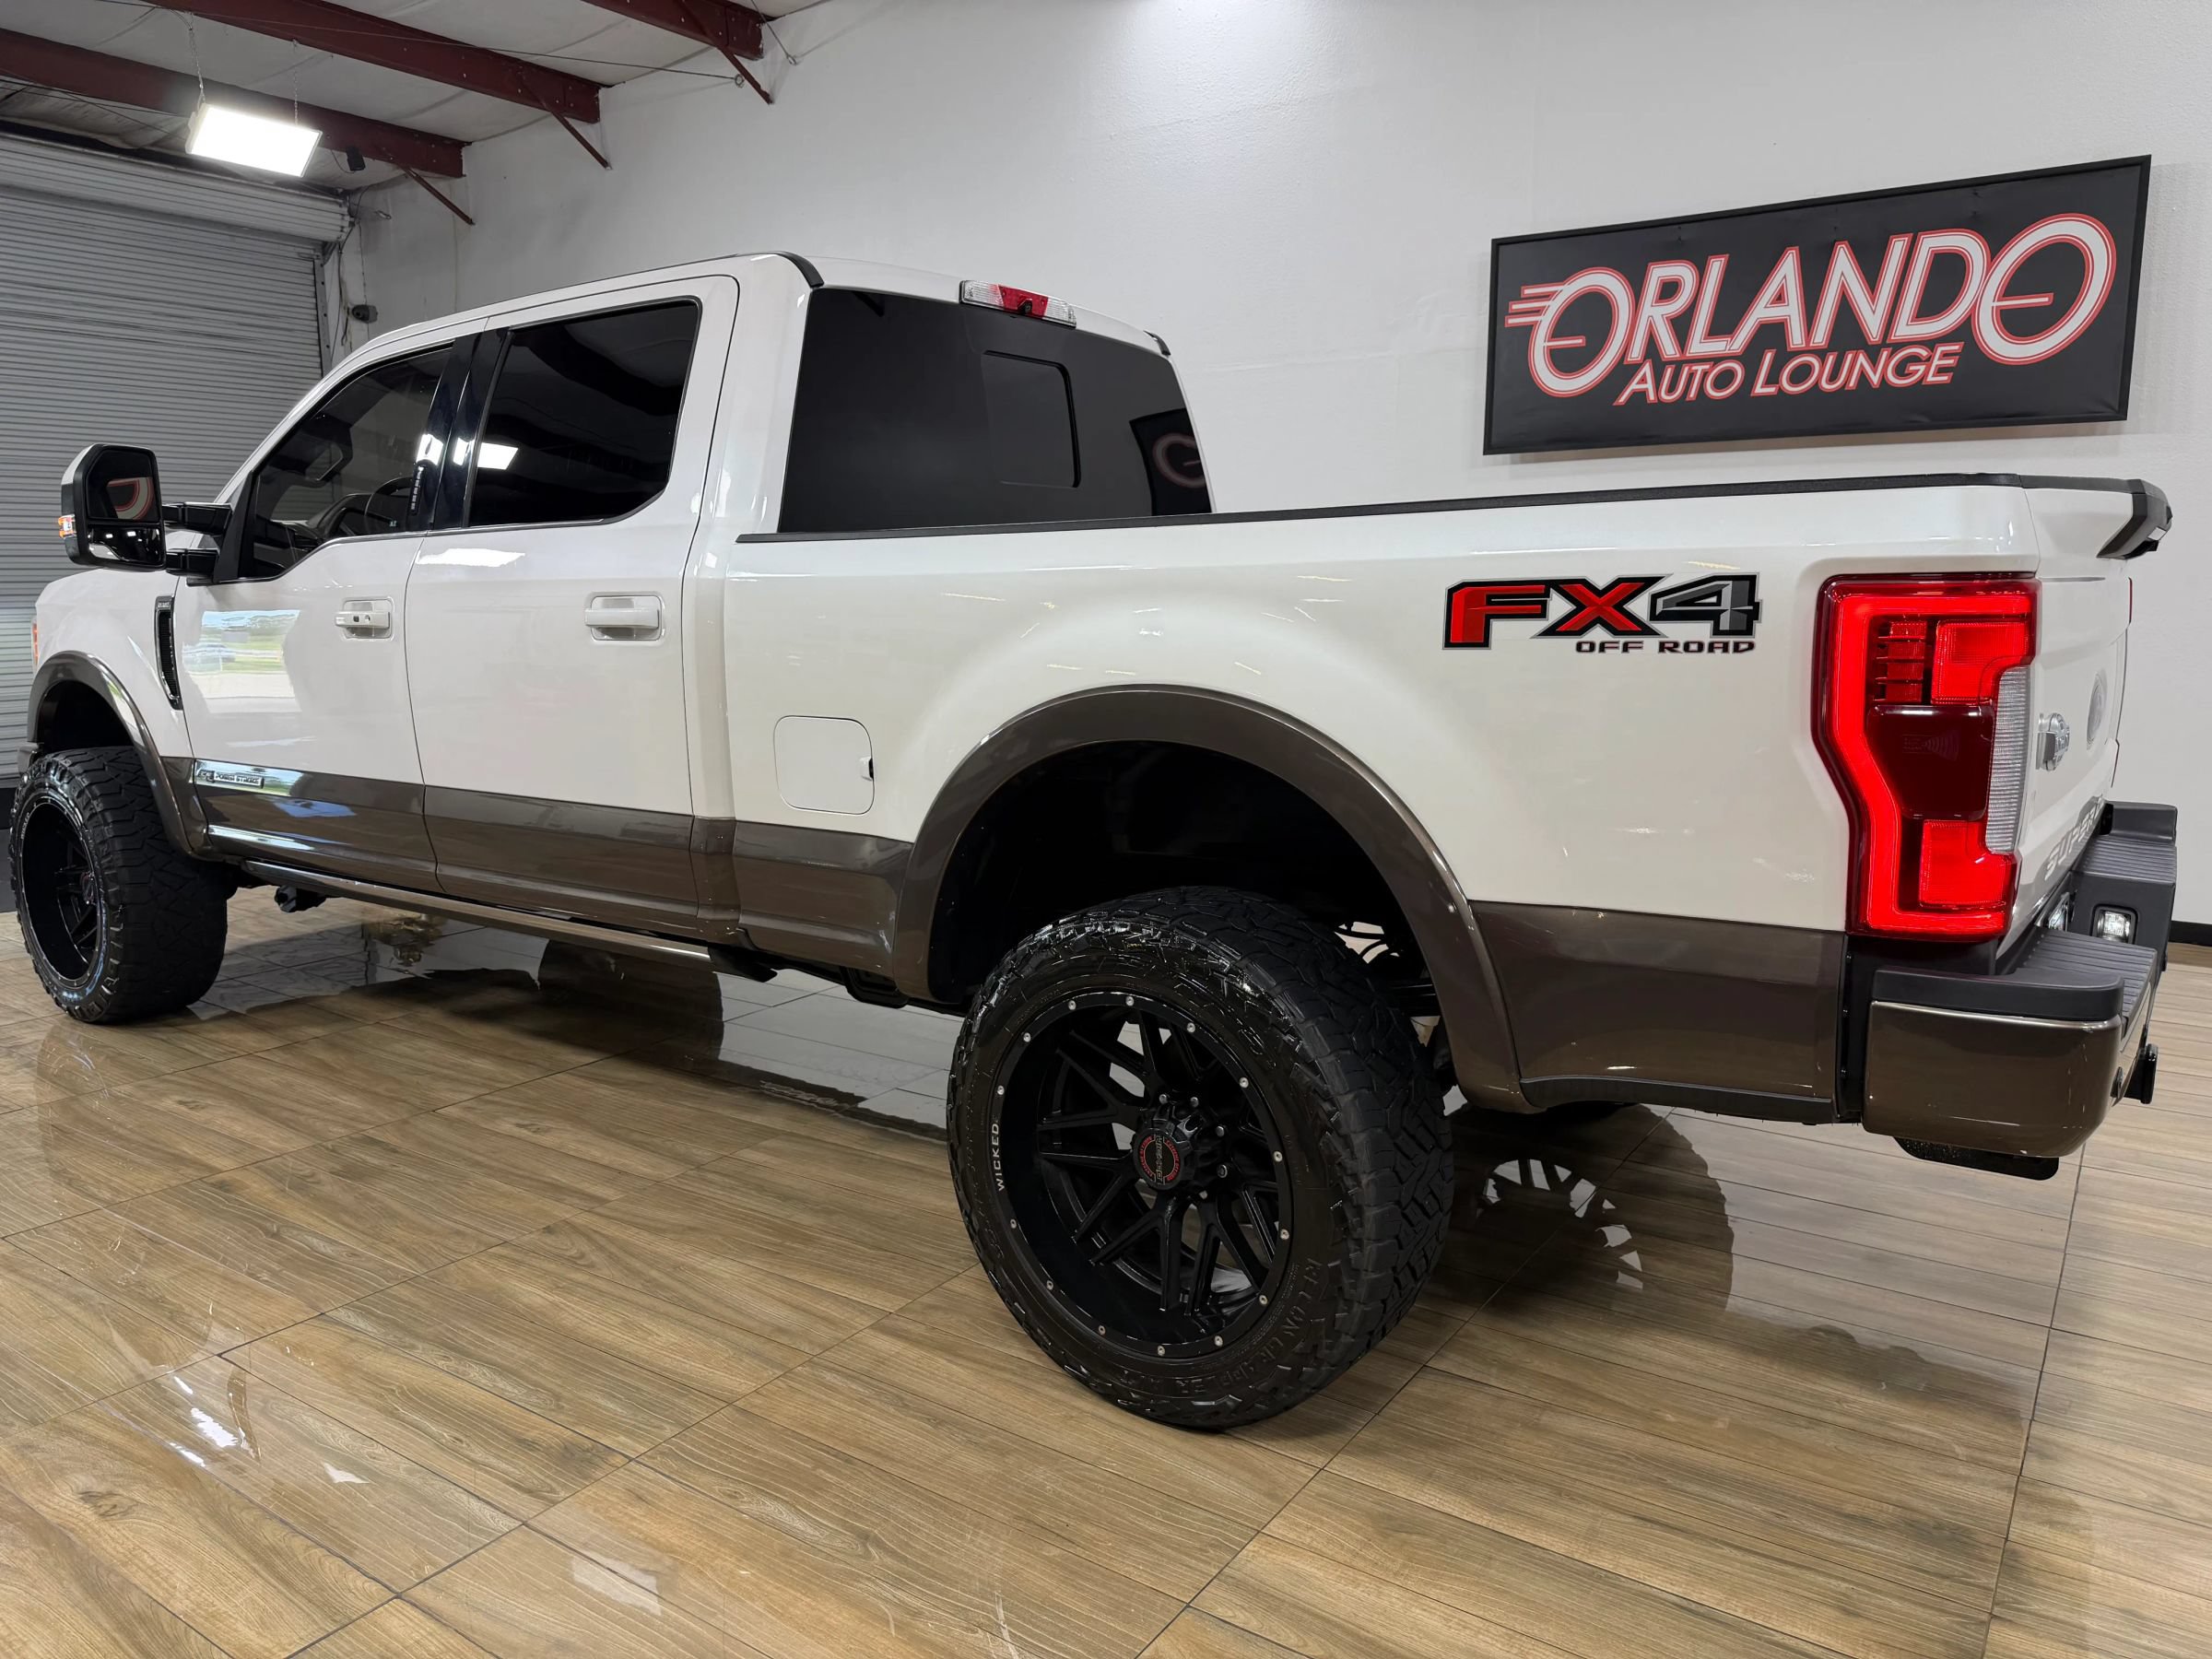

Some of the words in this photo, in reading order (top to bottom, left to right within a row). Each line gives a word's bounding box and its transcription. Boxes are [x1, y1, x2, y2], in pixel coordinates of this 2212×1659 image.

[1525, 213, 2117, 398] ORLANDO
[1613, 358, 1745, 406] AUTO
[1751, 342, 1964, 397] LOUNGE
[1442, 572, 1762, 651] FX4
[1575, 640, 1644, 654] OFF
[1657, 639, 1757, 655] ROAD
[991, 1123, 1006, 1192] WICKED
